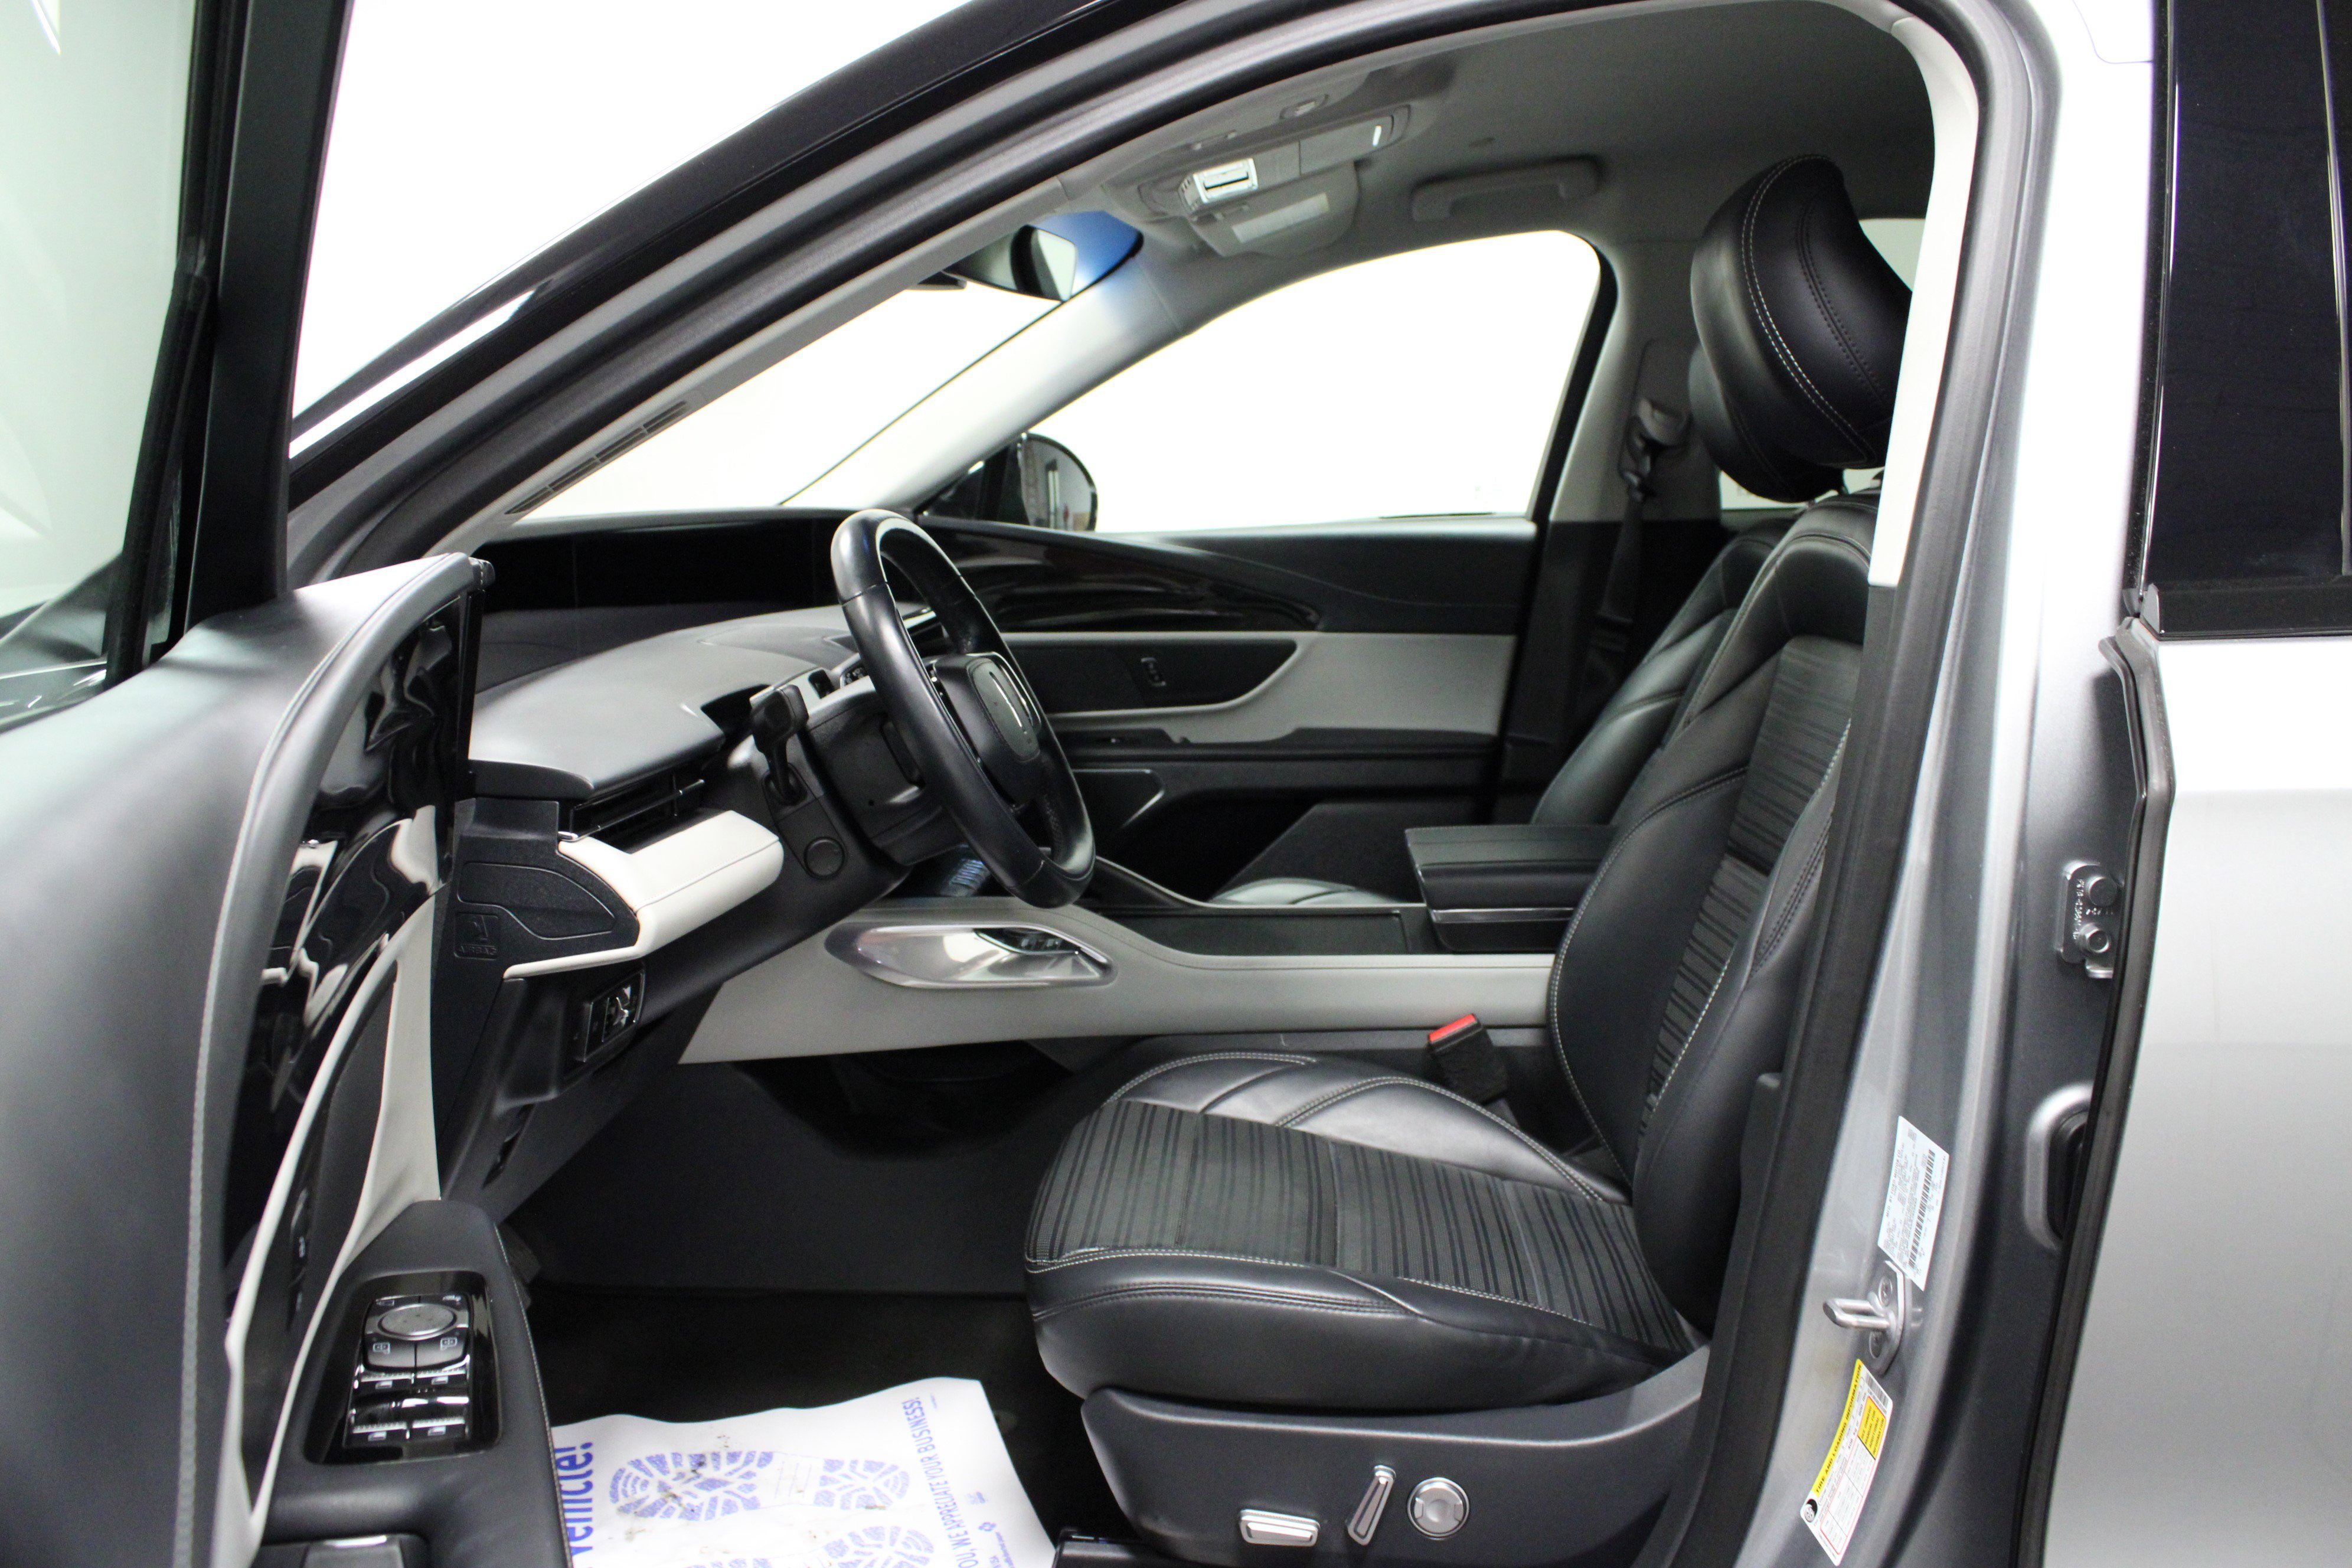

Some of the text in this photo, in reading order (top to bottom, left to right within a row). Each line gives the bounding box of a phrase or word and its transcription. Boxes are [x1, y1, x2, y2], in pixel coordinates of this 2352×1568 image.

[901, 1396, 979, 1568] OU, WE APPRECIATE YOUR BUSINESS!
[1816, 1478, 1825, 1493] TIRE
[1825, 1458, 1833, 1474] AND
[1832, 1422, 1847, 1456] LOADING
[1846, 1364, 1861, 1420] INFORMATION
[1873, 1418, 1884, 1455] INFORMATION
